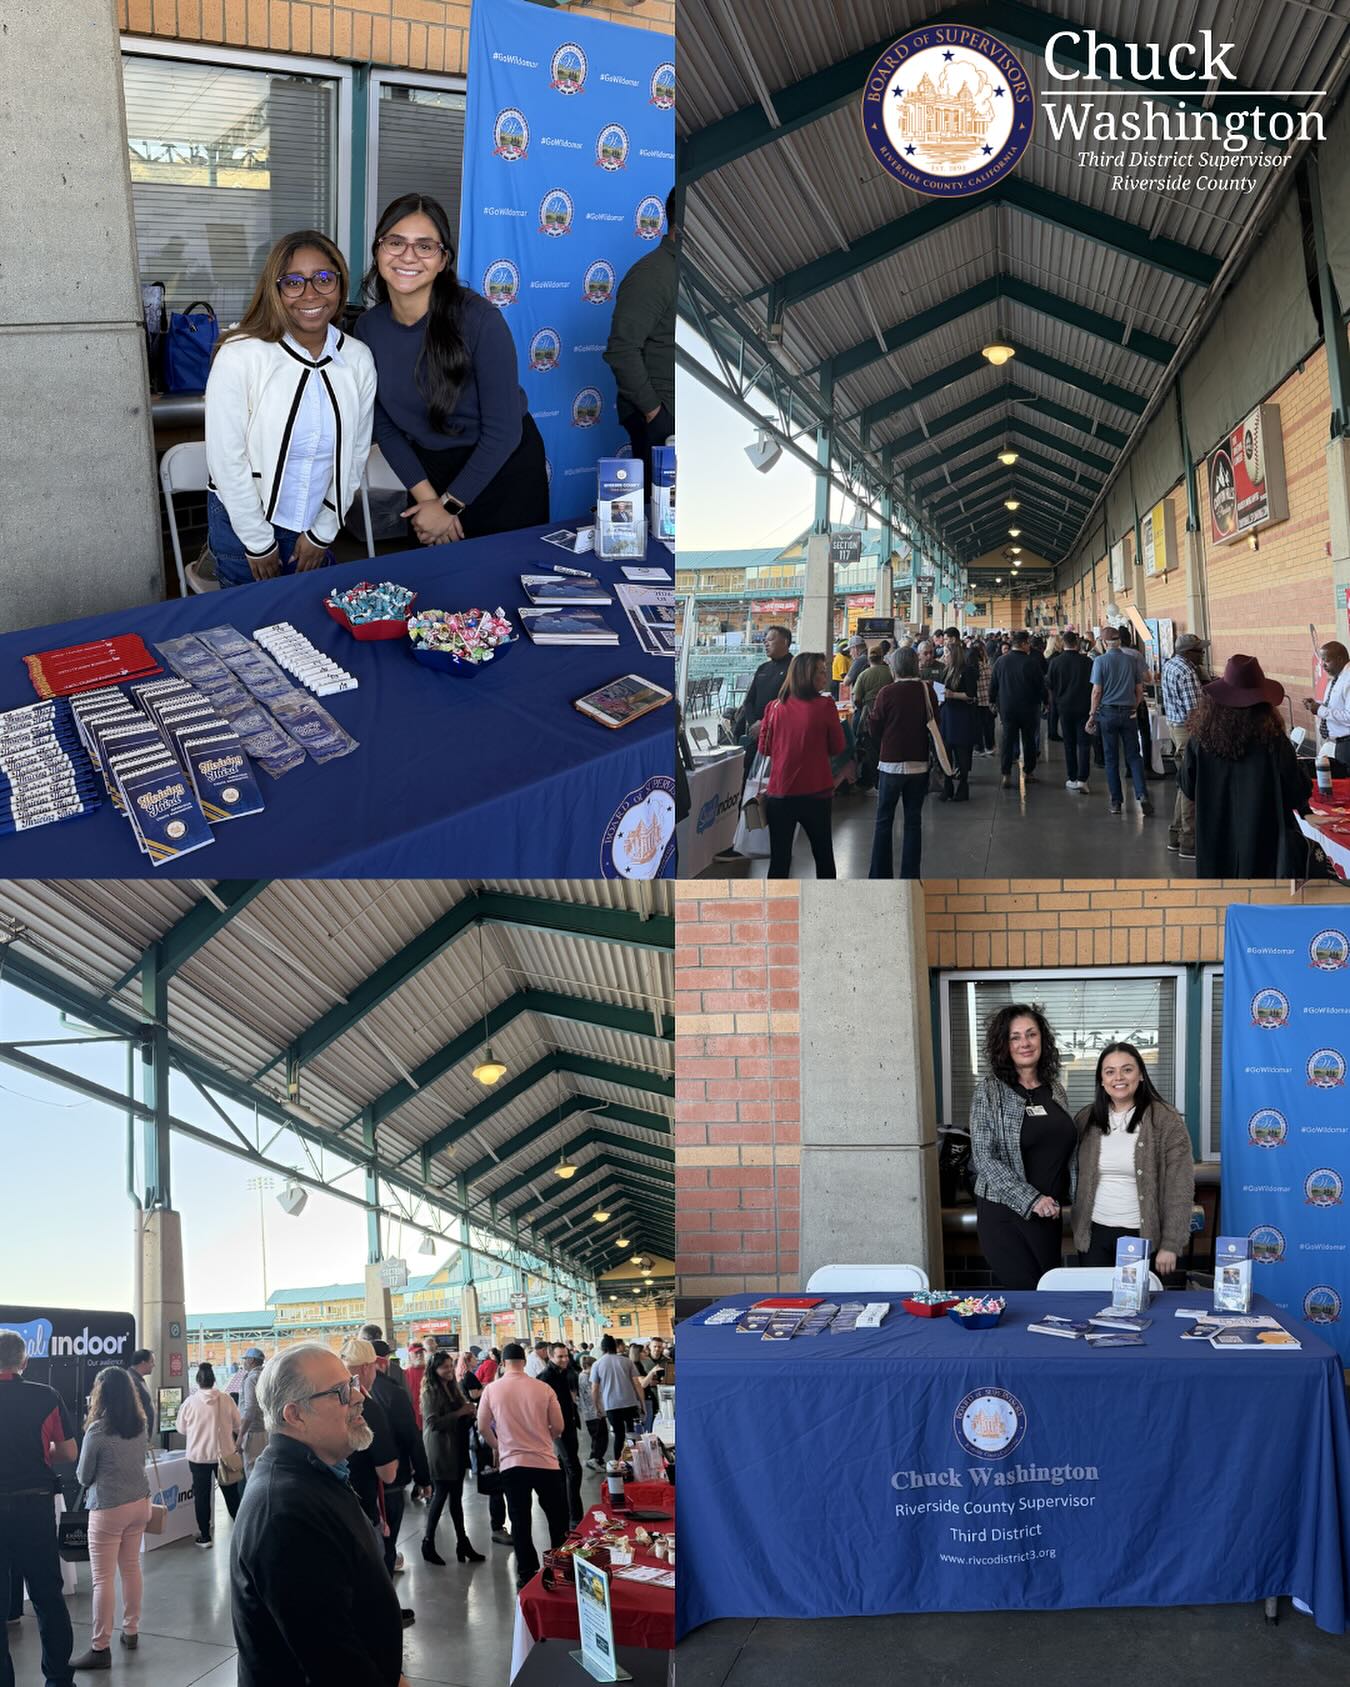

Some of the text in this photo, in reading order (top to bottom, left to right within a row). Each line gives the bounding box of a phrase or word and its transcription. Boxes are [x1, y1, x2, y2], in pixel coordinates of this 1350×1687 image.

[492, 52, 539, 68] #GoWildomar
[600, 73, 641, 87] #GoWildomar
[541, 136, 584, 150] #GoWildomar
[483, 206, 528, 217] #GoWildomar
[832, 541, 858, 550] SECTION
[839, 550, 850, 561] 117
[198, 755, 243, 775] Thriving
[205, 765, 239, 782] Third
[137, 783, 185, 809] Thriving
[146, 795, 182, 817] Third
[1246, 947, 1295, 955] #GoWildomar
[1301, 1126, 1348, 1134] #GoWildomar
[1243, 1184, 1291, 1192] #GoWildomar
[51, 1326, 127, 1356] indoor
[890, 1463, 1100, 1490] Chuck Washington
[895, 1494, 1096, 1517] Riverside County Supervisor
[950, 1523, 1043, 1543] Third District
[939, 1548, 1057, 1566] www.rivcodistrict3.org
